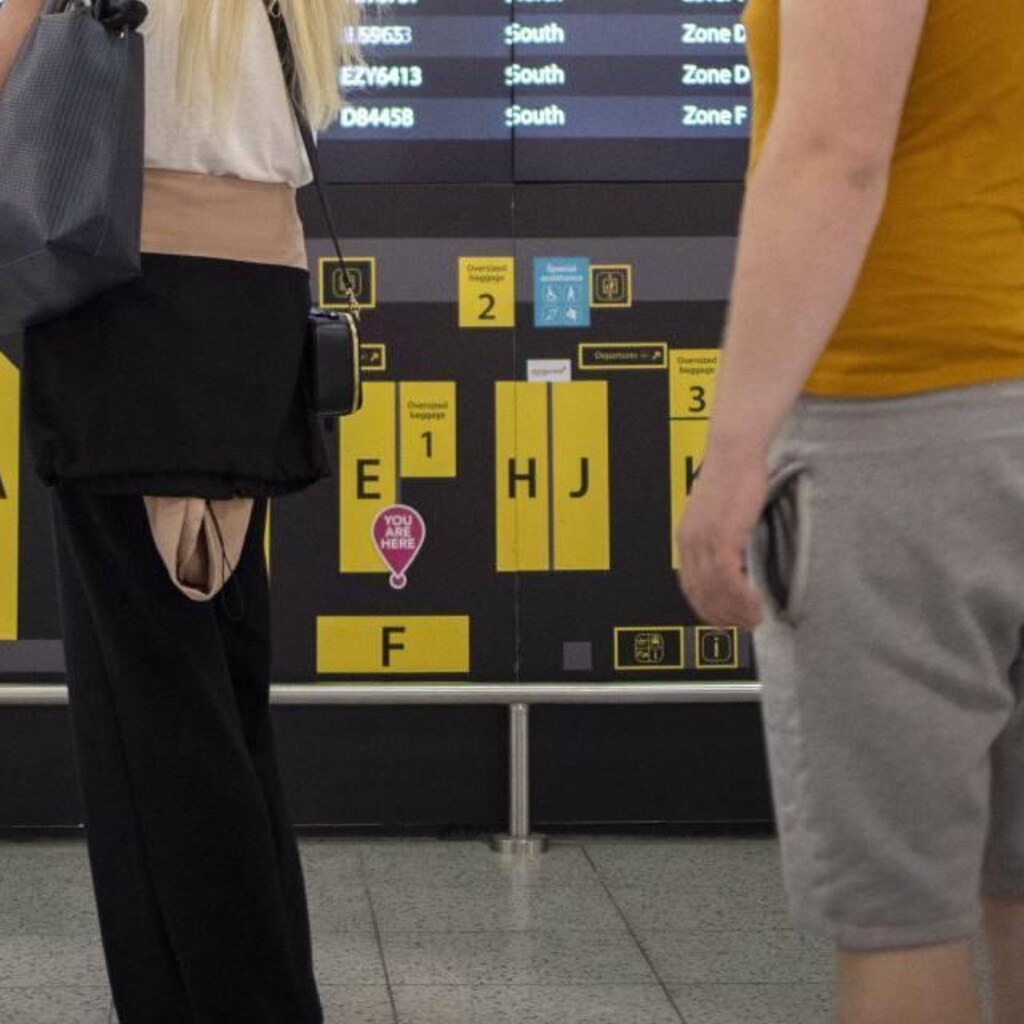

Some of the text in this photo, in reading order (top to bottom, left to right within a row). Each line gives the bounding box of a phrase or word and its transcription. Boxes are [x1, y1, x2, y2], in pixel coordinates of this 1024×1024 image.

[504, 22, 566, 45] South
[681, 23, 733, 44] Zone
[504, 63, 566, 86] South
[681, 64, 733, 85] Zone
[733, 64, 752, 85] D
[504, 104, 566, 127] South
[682, 104, 733, 126] Zone
[733, 104, 748, 126] F
[477, 293, 496, 321] 2
[688, 385, 707, 413] 3
[420, 430, 433, 459] 1
[355, 458, 382, 500] E
[507, 457, 538, 499] H
[568, 457, 590, 499] J
[384, 514, 413, 527] YOU
[385, 525, 412, 538] ARE
[380, 537, 417, 551] HERE
[380, 626, 407, 668] F
